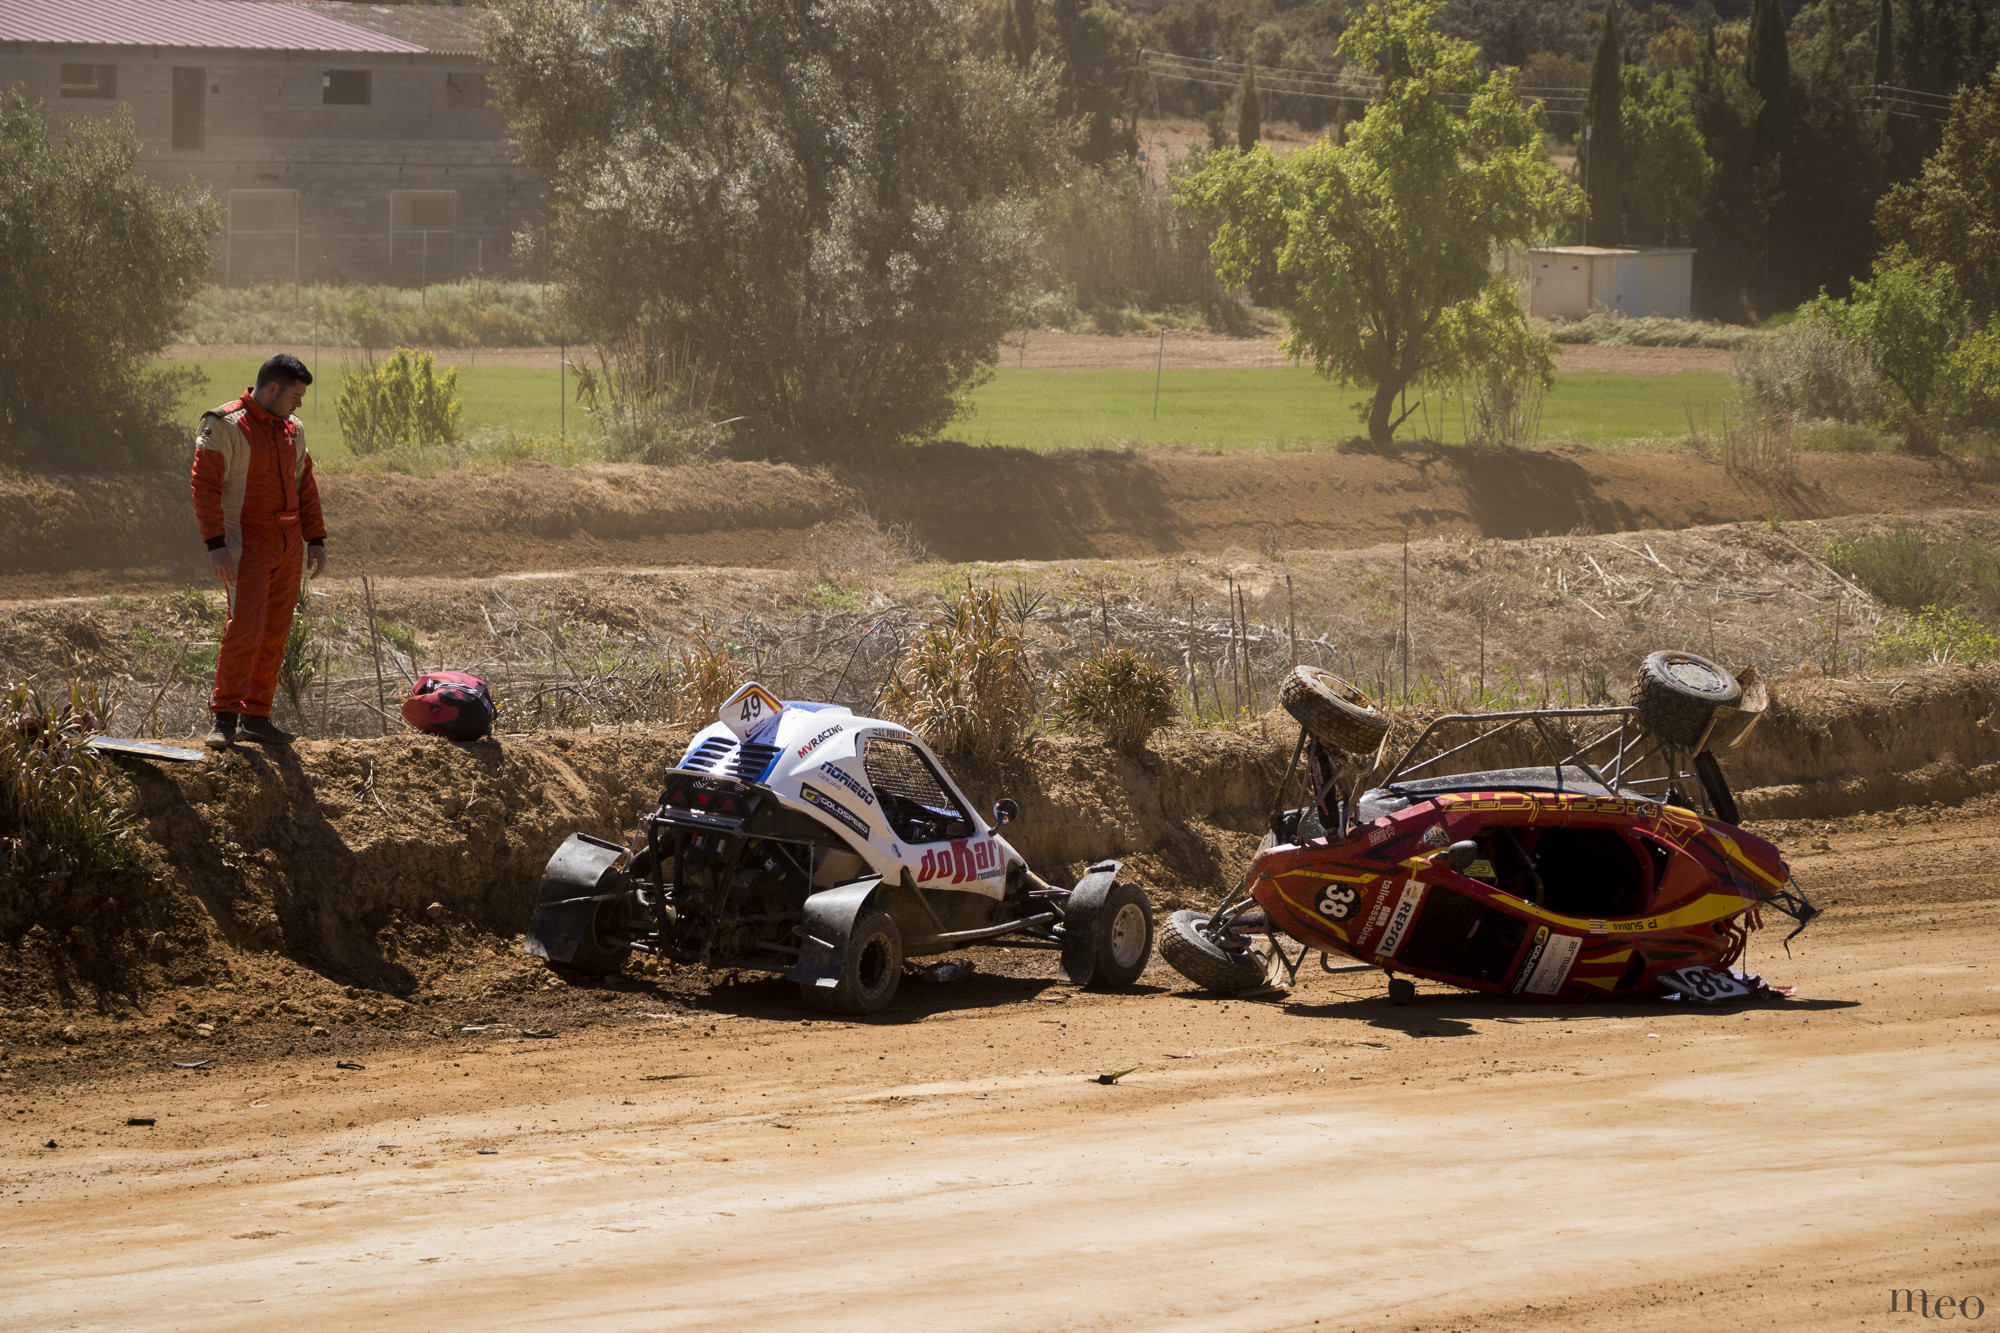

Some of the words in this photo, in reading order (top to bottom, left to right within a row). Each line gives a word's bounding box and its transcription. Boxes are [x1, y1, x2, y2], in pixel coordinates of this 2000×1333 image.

[740, 693, 761, 722] 49
[820, 797, 868, 834] GOLDSPEED
[1318, 884, 1356, 918] 38
[1379, 900, 1413, 953] REPSOL
[1512, 944, 1543, 994] GOLDSPEED
[1684, 969, 1734, 998] 38
